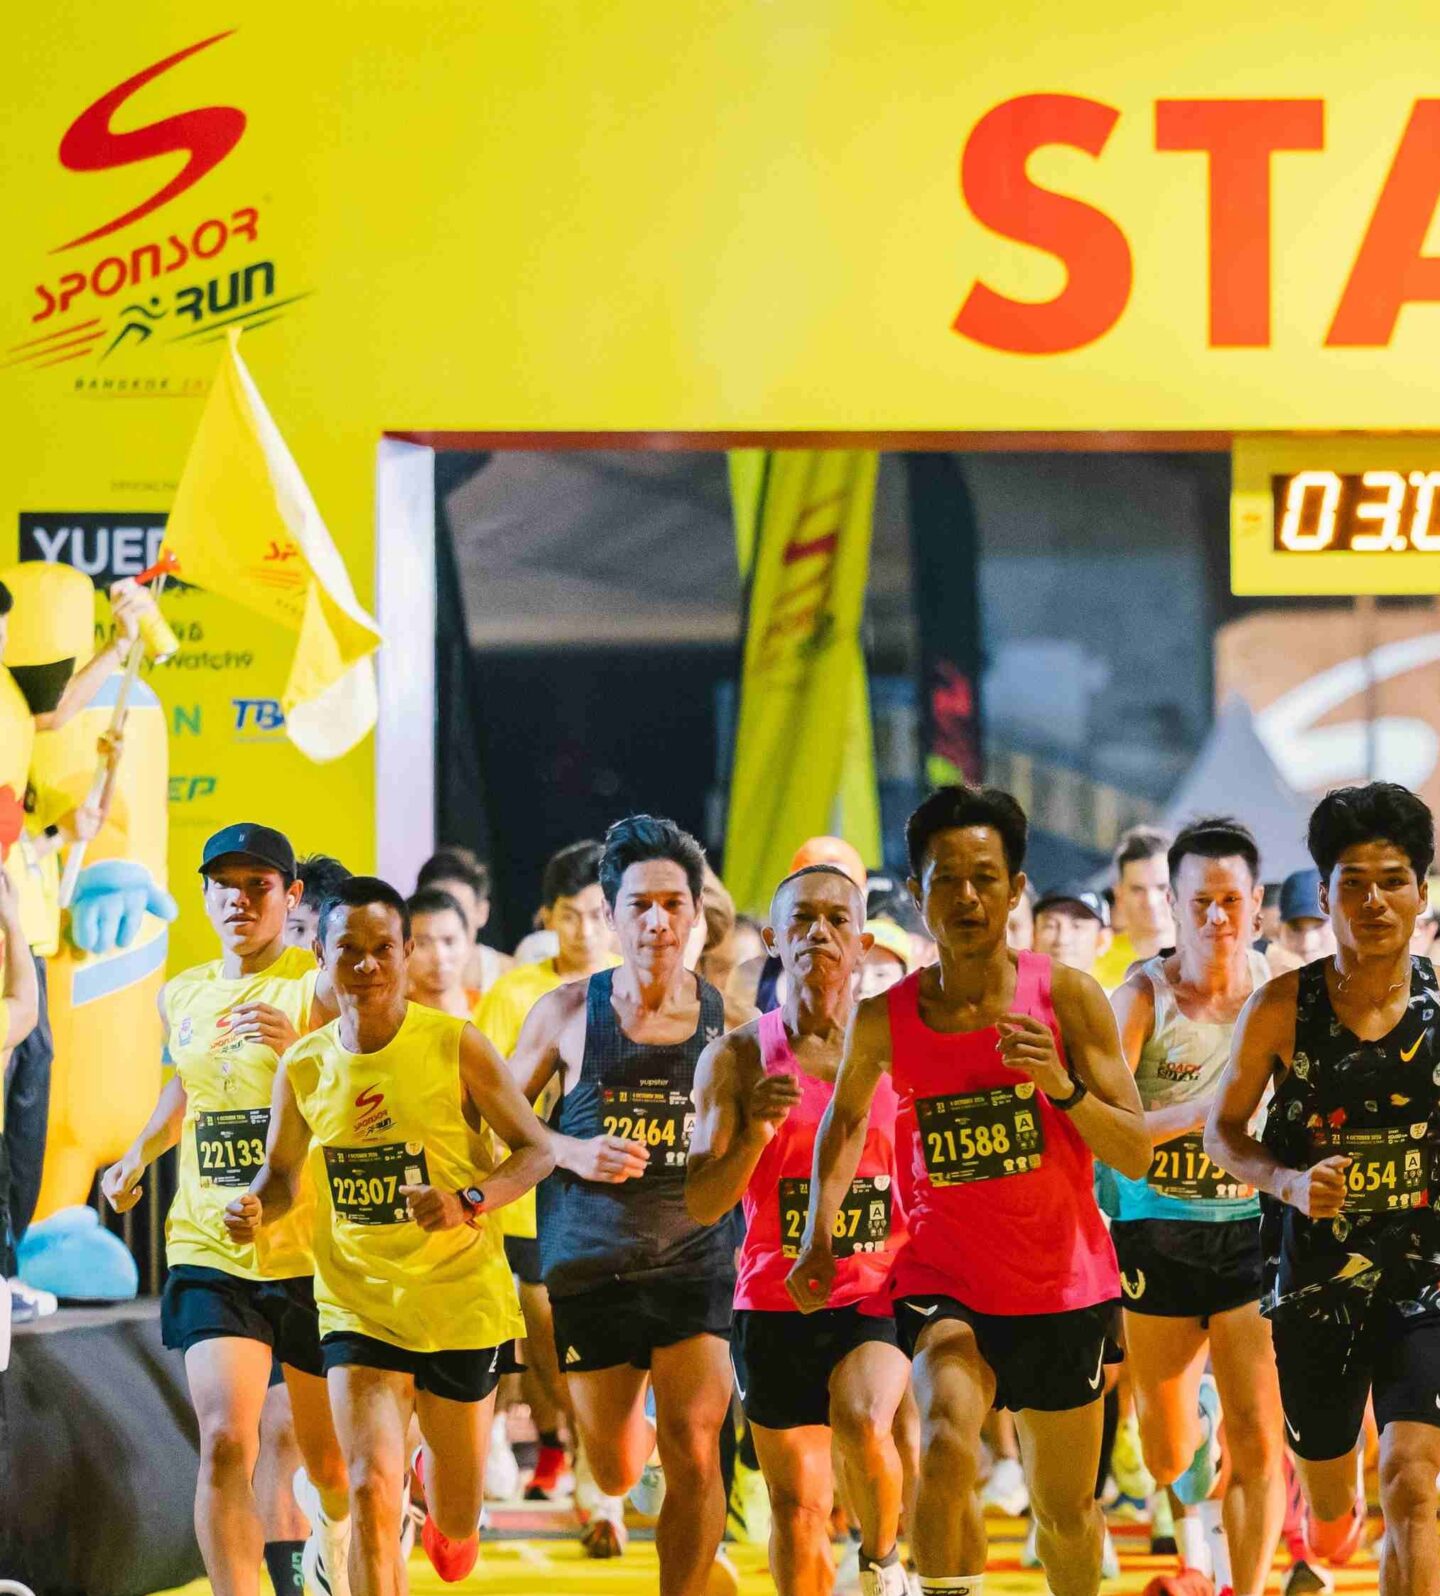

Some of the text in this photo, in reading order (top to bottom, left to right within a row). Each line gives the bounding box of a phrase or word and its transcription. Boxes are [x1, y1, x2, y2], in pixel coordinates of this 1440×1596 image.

[32, 207, 260, 323] SPONSOR
[176, 261, 275, 322] RUN
[603, 1116, 676, 1146] 22464
[1019, 1118, 1030, 1129] A
[201, 1139, 265, 1169] 22133
[927, 1123, 1010, 1163] 21588
[333, 1176, 398, 1205] 22307
[1345, 1160, 1397, 1191] 654
[786, 1209, 862, 1238] 287
[873, 1207, 882, 1217] A
